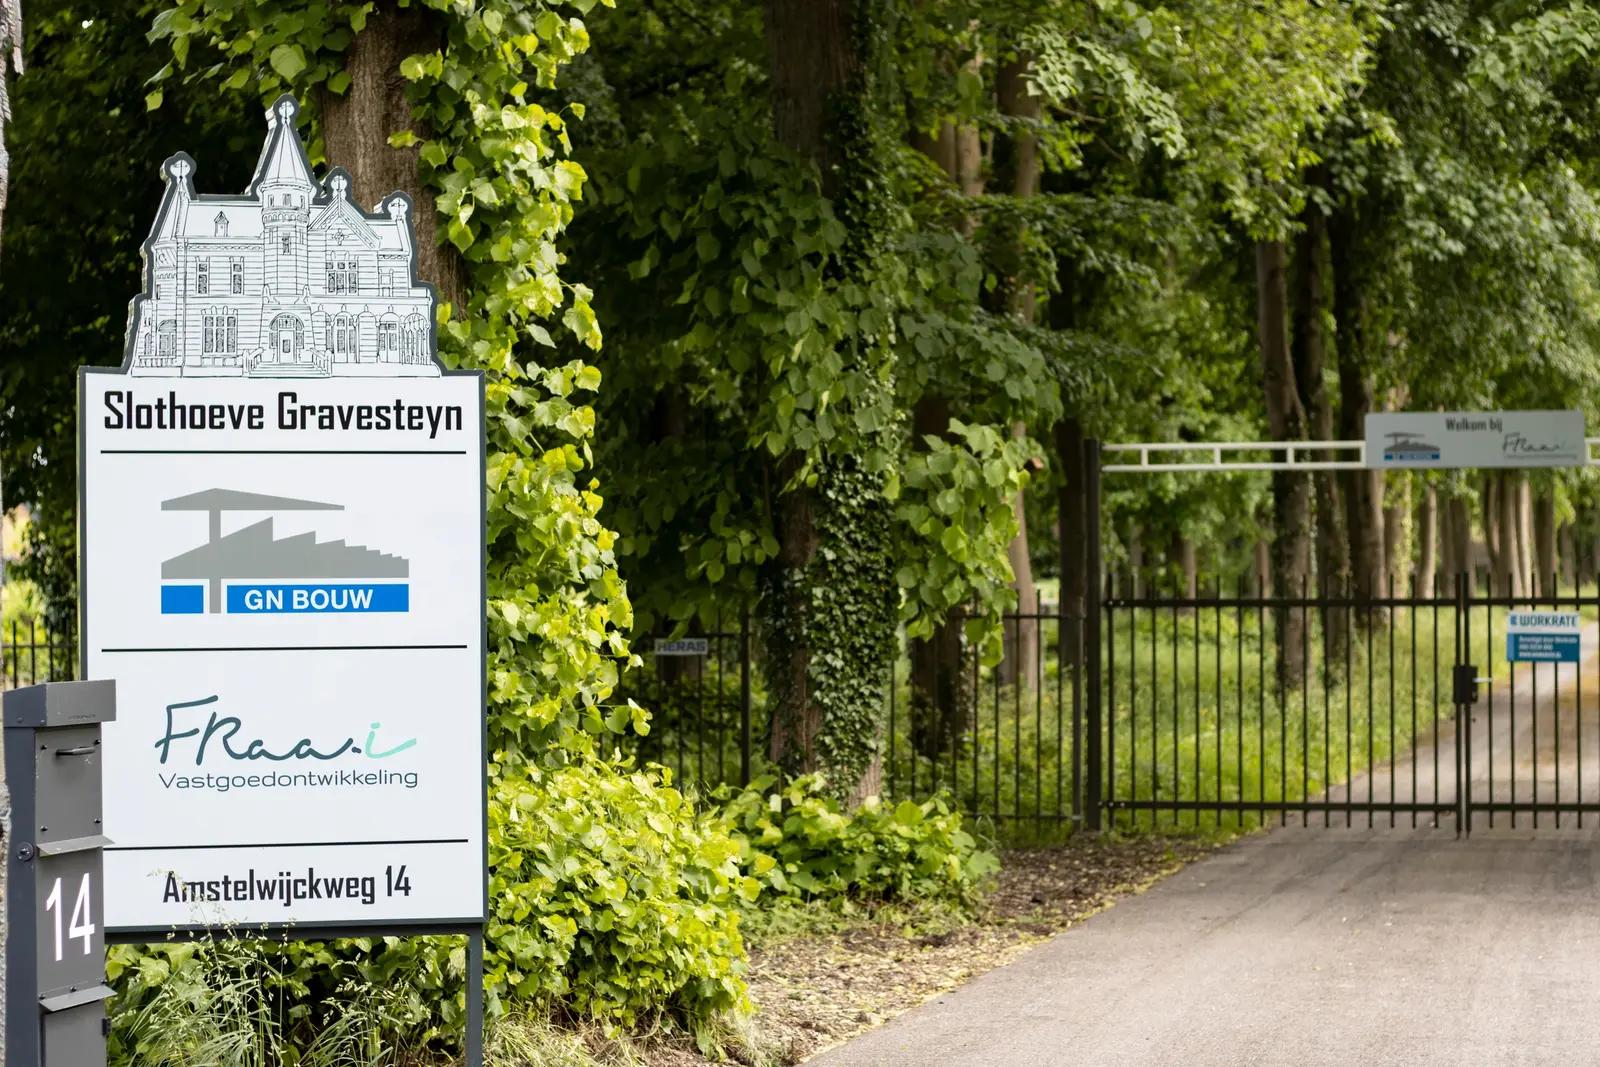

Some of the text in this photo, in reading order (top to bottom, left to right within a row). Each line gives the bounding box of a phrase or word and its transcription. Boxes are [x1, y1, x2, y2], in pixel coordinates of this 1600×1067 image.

[104, 390, 462, 440] Slothoeve Gravesteyn
[245, 590, 373, 610] GN BOUW
[1519, 614, 1577, 627] WORKRATE
[158, 769, 418, 793] Vastgoedontwikkeling
[162, 864, 413, 907] Amstelwijckweg 14
[46, 872, 96, 962] 14
